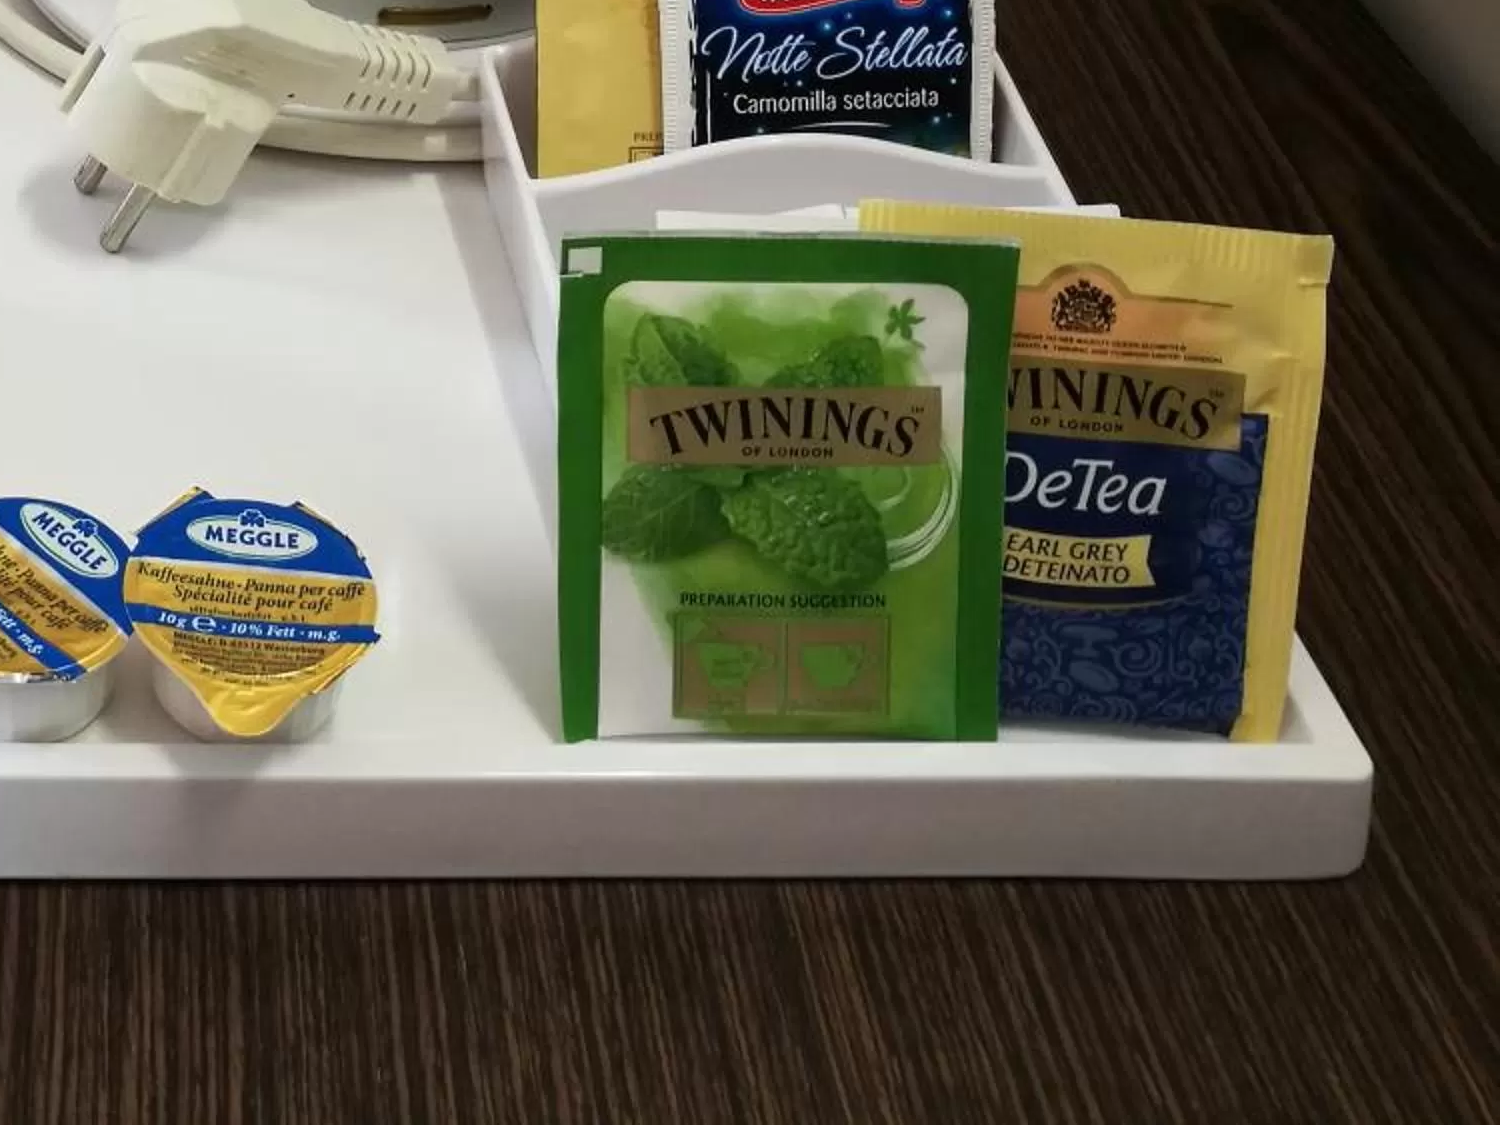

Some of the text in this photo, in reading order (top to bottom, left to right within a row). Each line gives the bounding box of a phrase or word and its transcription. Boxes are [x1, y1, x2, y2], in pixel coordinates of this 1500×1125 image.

[701, 26, 968, 83] Notte Stellata
[733, 86, 939, 114] Camomilla setacciata
[1008, 368, 1218, 441] ININGS
[650, 396, 920, 458] TWININGS
[1030, 415, 1124, 432] OF LONDON
[741, 446, 834, 459] OF LONDON
[1005, 451, 1168, 516] DeTea
[31, 511, 109, 572] MEGGLE
[205, 525, 300, 549] MEGGLE
[1006, 533, 1129, 562] EARL GREY
[1003, 554, 1131, 584] DETEINATO
[244, 578, 296, 595] Panna
[298, 583, 326, 599] per
[680, 592, 886, 608] PREPARATION SUGGESTION
[254, 595, 296, 612] pour
[299, 595, 333, 616] café
[266, 625, 296, 638] Fett
